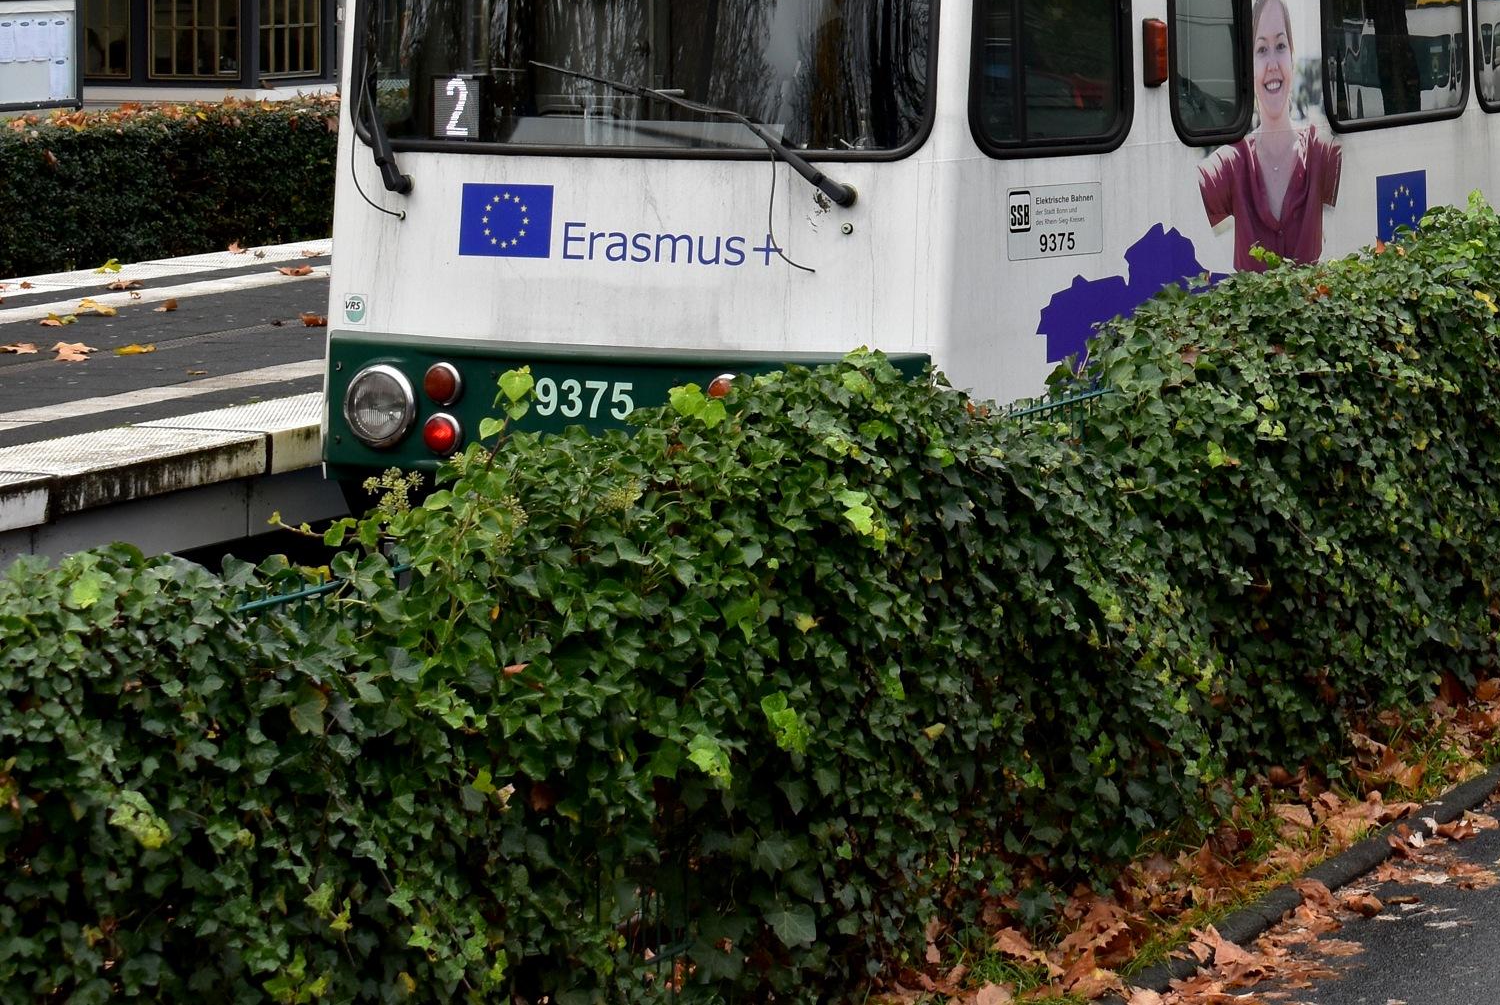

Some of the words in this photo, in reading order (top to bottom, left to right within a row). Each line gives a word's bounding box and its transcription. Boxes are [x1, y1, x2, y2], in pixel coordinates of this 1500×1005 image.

[446, 78, 469, 137] 2
[1035, 196, 1069, 205] Elektrische
[1071, 194, 1094, 203] Bahnen
[1010, 204, 1030, 227] SSB
[1039, 232, 1075, 252] 9375
[345, 301, 361, 310] VRS
[535, 377, 635, 420] 9375
